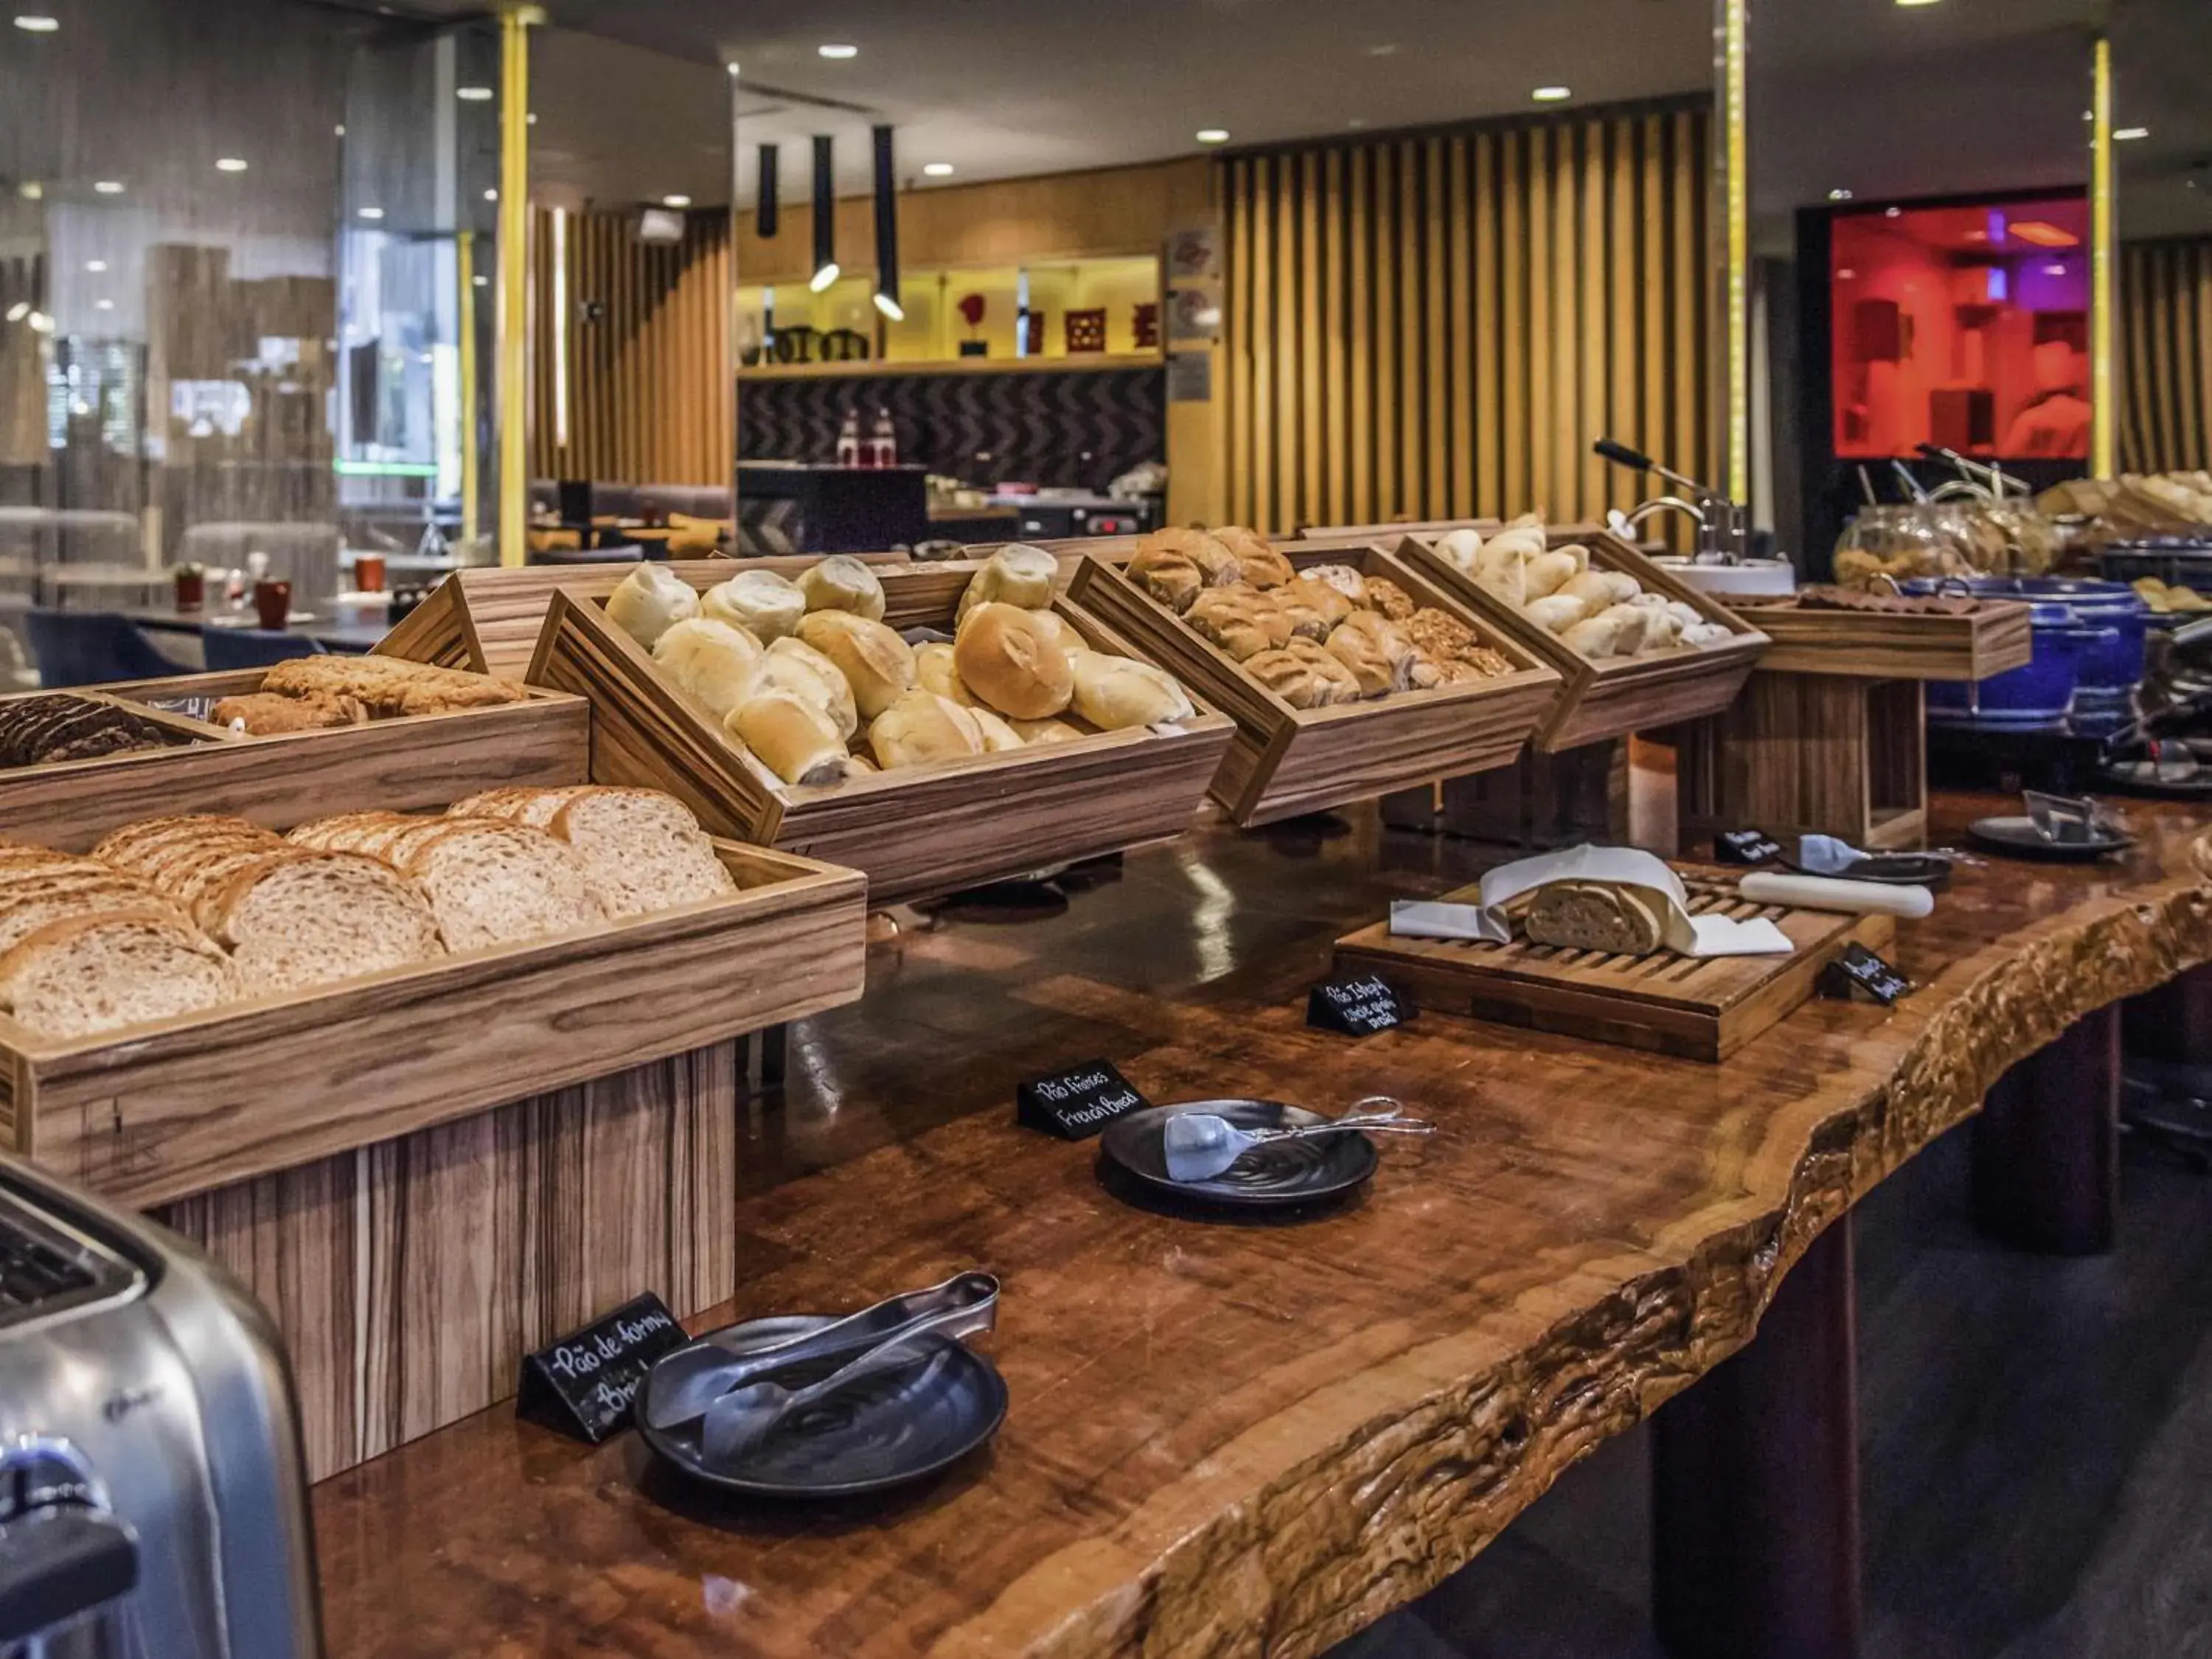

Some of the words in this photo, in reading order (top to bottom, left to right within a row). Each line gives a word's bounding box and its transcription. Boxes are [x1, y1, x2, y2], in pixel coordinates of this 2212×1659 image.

[1034, 1080, 1068, 1101] Pão
[552, 1344, 601, 1379] Pão
[594, 1334, 623, 1360] de
